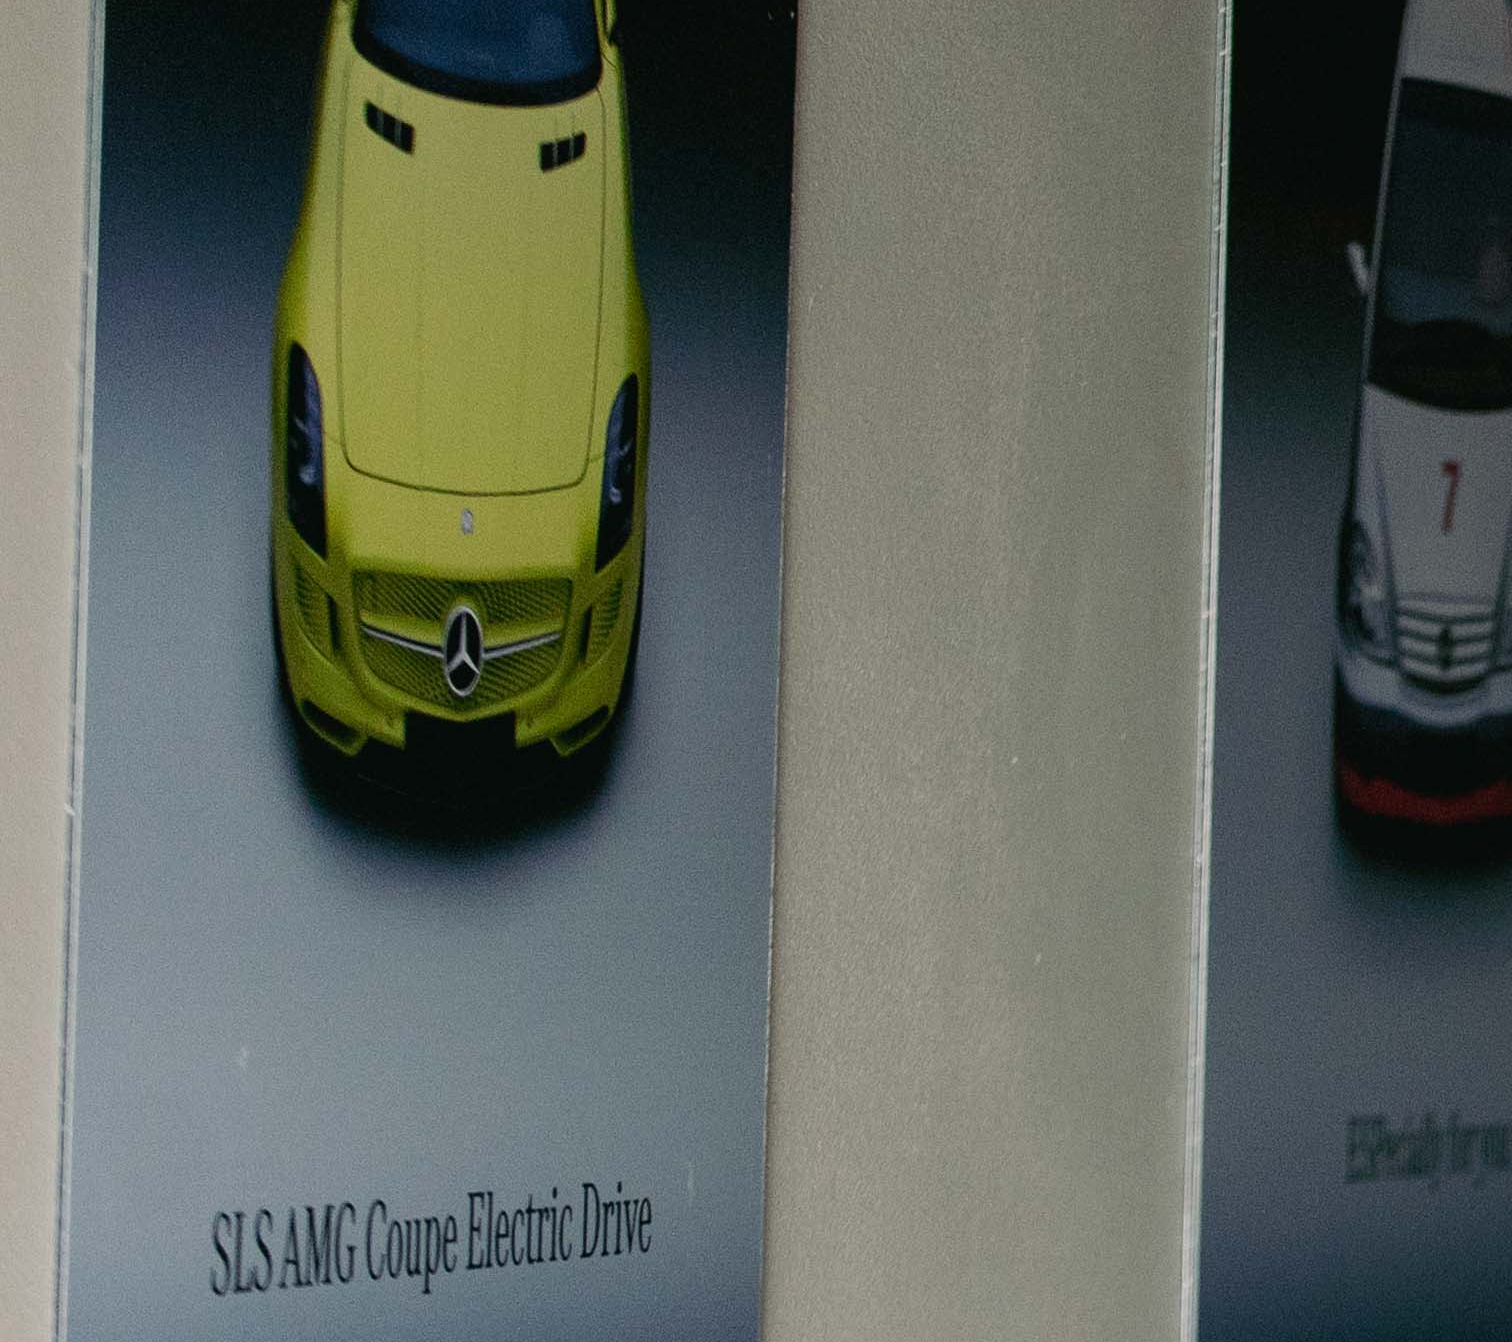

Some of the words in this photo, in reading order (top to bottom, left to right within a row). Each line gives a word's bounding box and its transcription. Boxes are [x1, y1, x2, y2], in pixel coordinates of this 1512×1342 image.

[210, 1209, 274, 1297] SLS
[278, 1201, 357, 1290] AMG
[364, 1198, 459, 1294] Coupe
[464, 1186, 574, 1271] Electric
[580, 1180, 653, 1260] Drive
